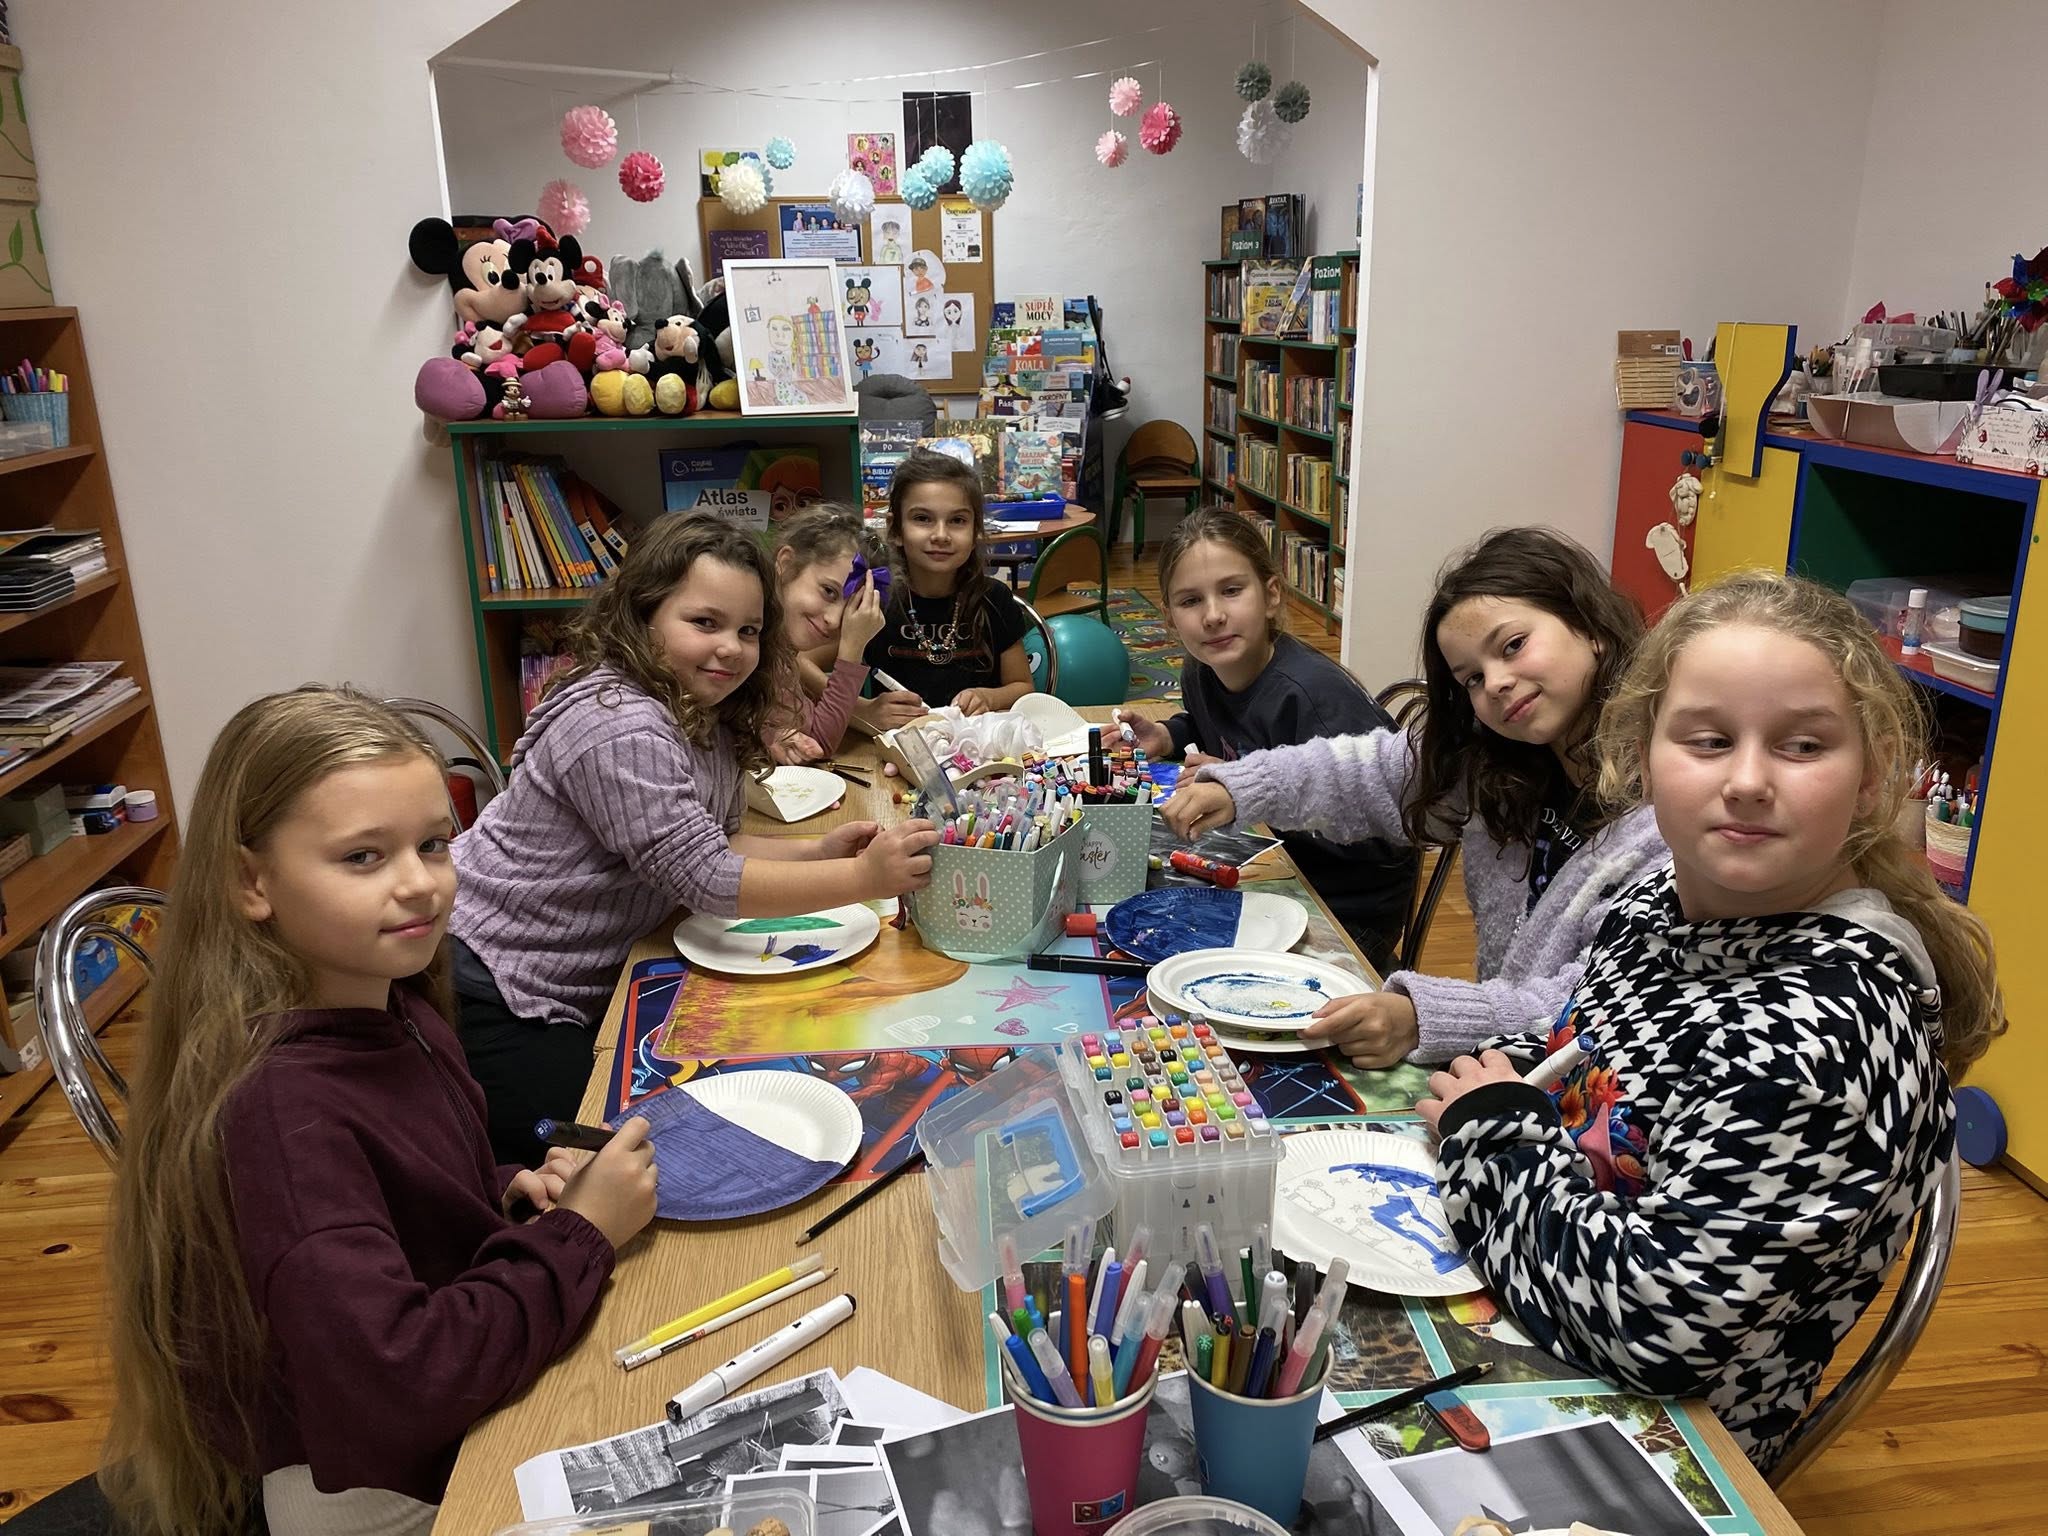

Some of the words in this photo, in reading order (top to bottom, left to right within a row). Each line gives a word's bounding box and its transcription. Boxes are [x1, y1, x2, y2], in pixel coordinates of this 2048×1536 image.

[1025, 300, 1054, 312] SUPER
[1026, 311, 1053, 321] MOCY
[1015, 359, 1045, 371] KOALA
[872, 467, 893, 476] BIBLIA
[697, 488, 748, 506] Atlas
[1080, 846, 1111, 870] aster
